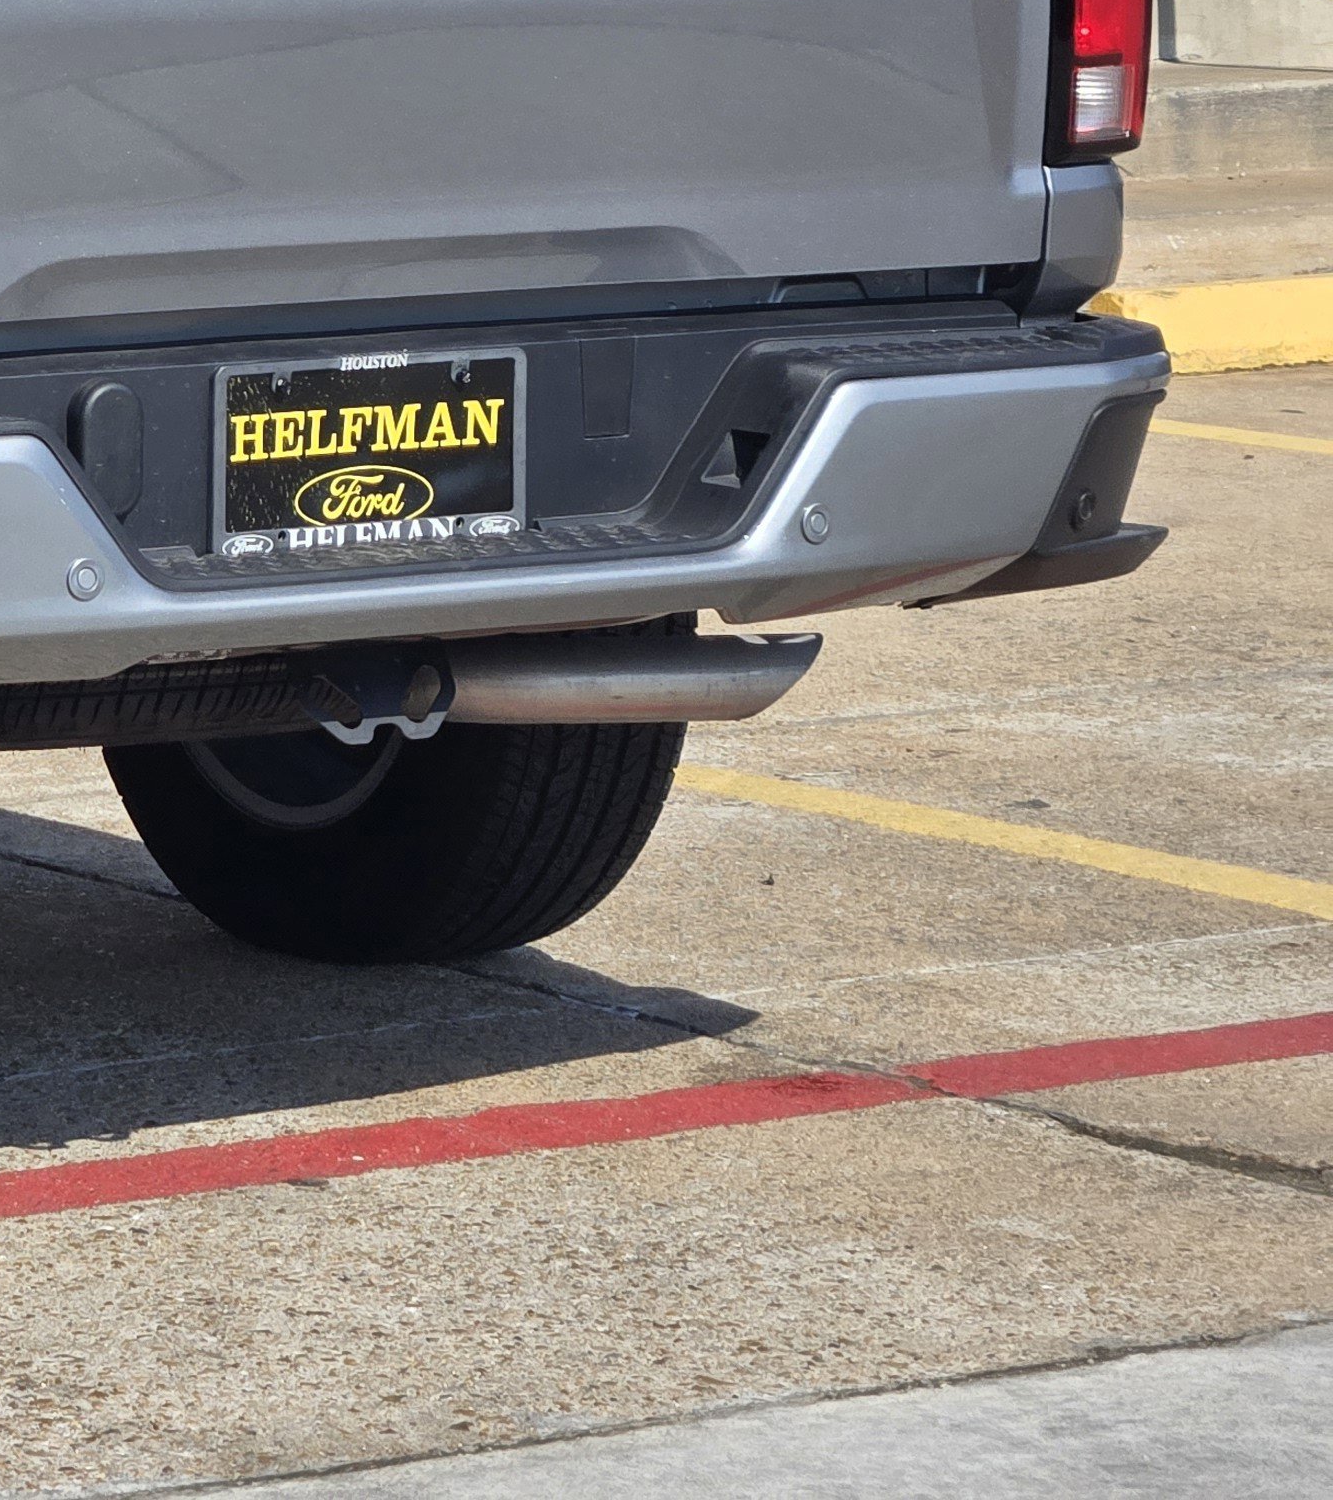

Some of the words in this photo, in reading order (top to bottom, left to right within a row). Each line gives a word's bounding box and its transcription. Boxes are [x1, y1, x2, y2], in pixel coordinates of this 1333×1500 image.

[340, 353, 409, 372] HOUSTON
[229, 398, 505, 463] HELFMAN
[321, 474, 406, 521] Ford
